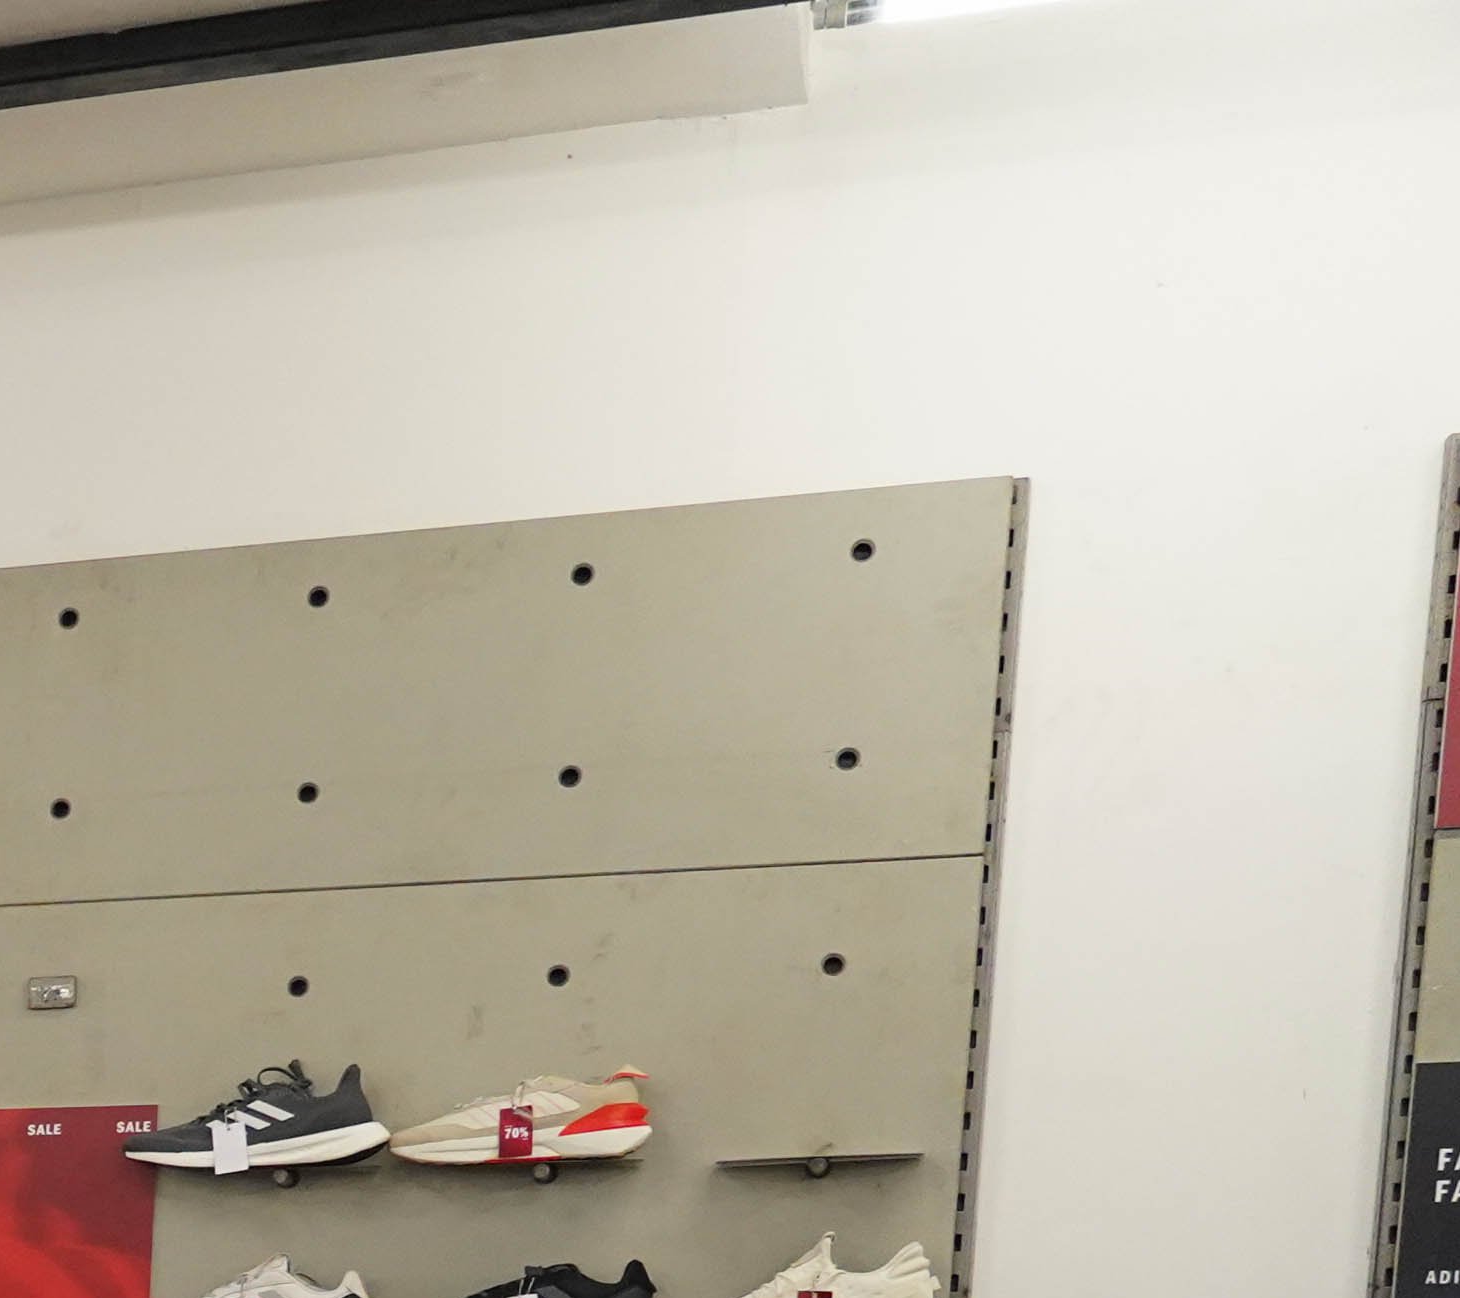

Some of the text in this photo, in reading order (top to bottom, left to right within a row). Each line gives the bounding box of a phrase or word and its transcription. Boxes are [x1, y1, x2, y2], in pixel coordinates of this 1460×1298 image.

[27, 1123, 62, 1136] SALE
[116, 1121, 152, 1134] SALE
[504, 1126, 528, 1138] 70%
